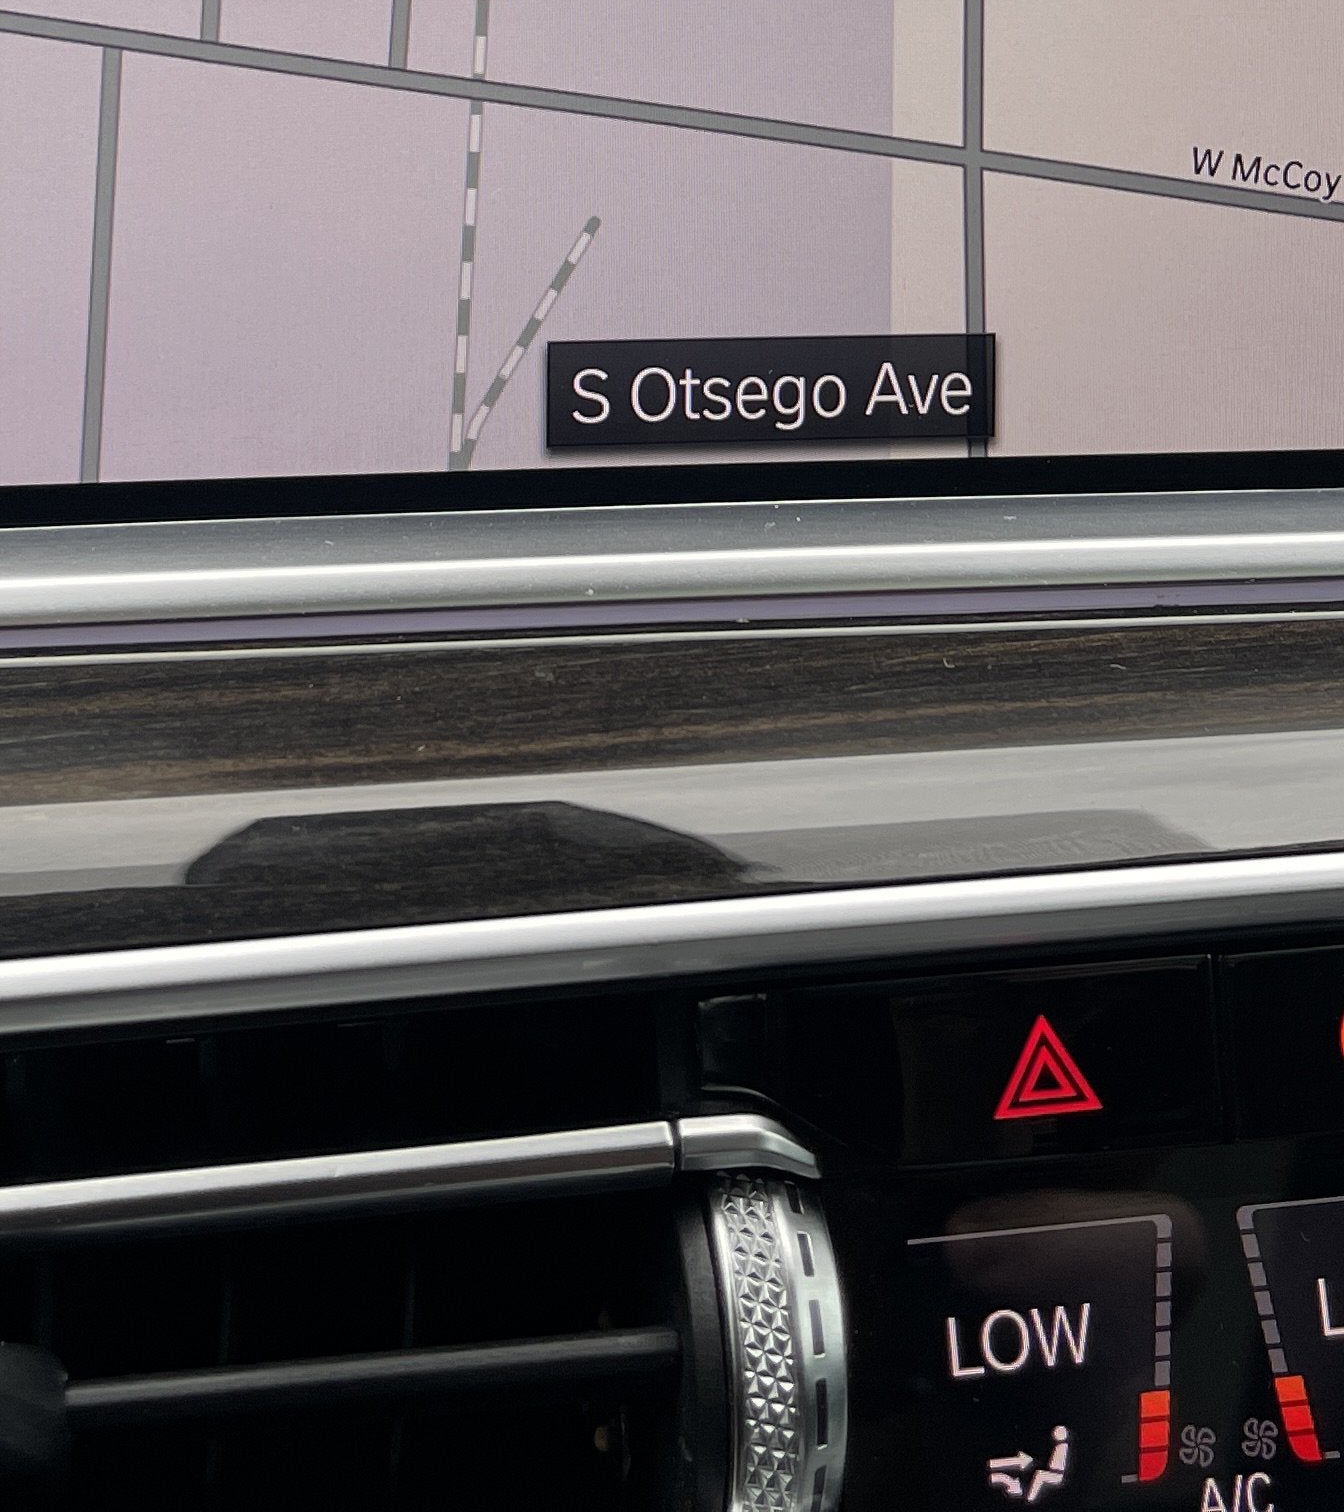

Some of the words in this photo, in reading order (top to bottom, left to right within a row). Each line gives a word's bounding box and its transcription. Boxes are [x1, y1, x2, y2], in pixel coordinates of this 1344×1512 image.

[1192, 146, 1225, 178] W
[1231, 153, 1343, 201] McCoy
[571, 368, 611, 425] S
[630, 365, 848, 431] Otsego
[864, 361, 973, 416] Ave
[945, 1302, 1092, 1378] LOW
[1201, 1471, 1275, 1512] A/C
